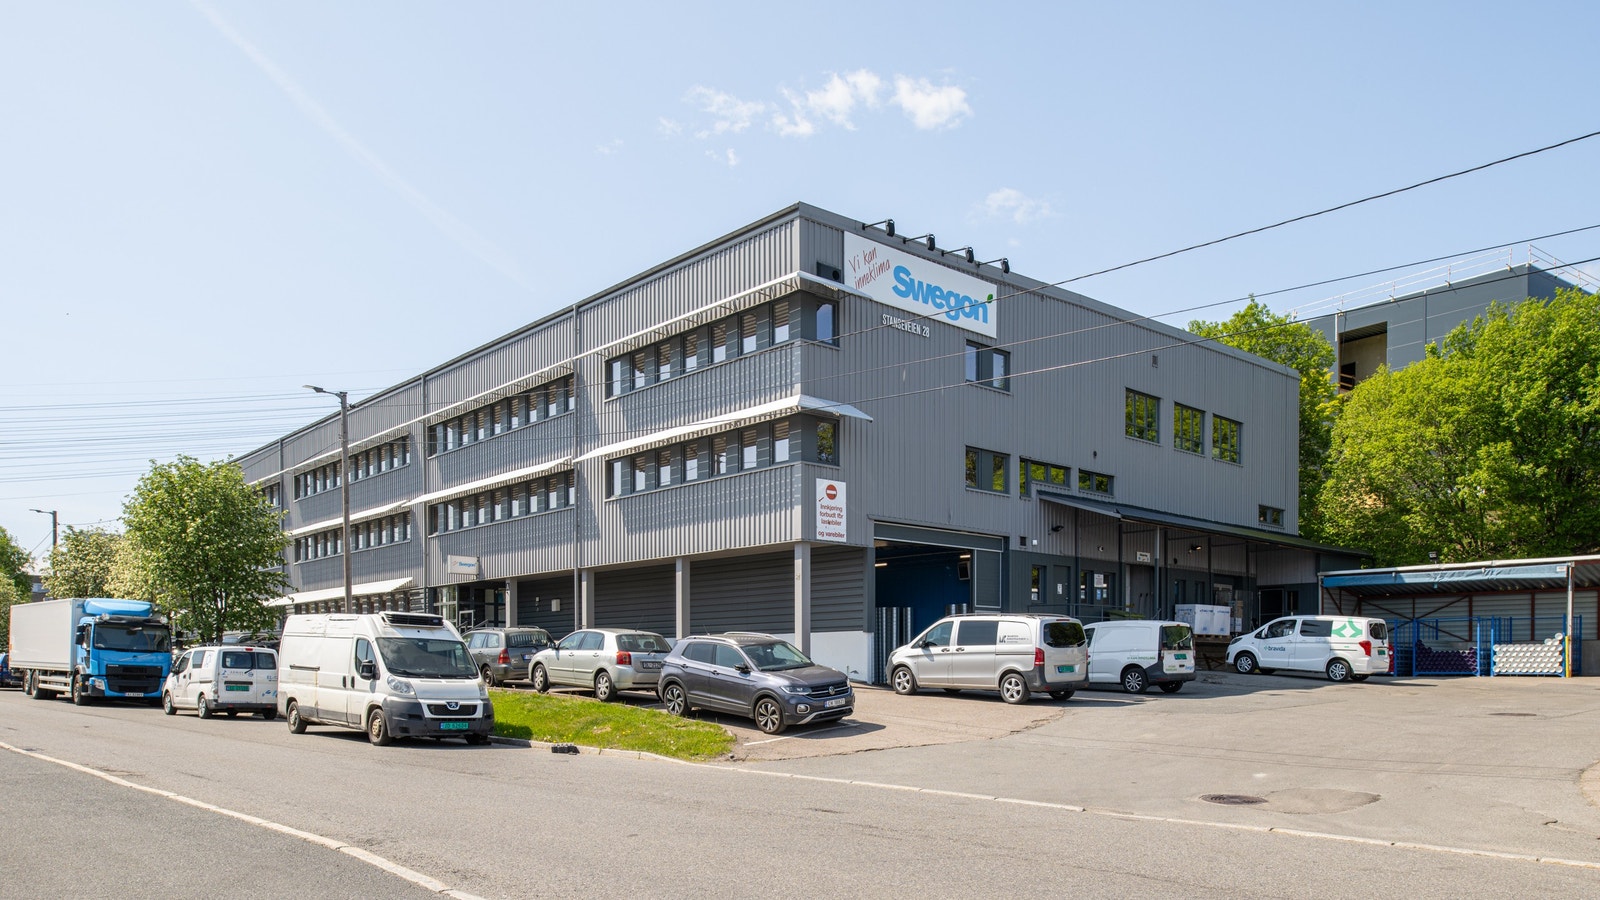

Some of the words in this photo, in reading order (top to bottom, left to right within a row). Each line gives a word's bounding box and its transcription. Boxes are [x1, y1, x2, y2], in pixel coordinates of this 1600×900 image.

[849, 254, 860, 273] Vi
[863, 247, 877, 266] kan
[855, 259, 890, 290] inneklima
[892, 265, 988, 324] Swegon
[882, 313, 921, 335] STANSEVEIEN
[922, 326, 930, 338] 28
[819, 511, 836, 519] forbudt
